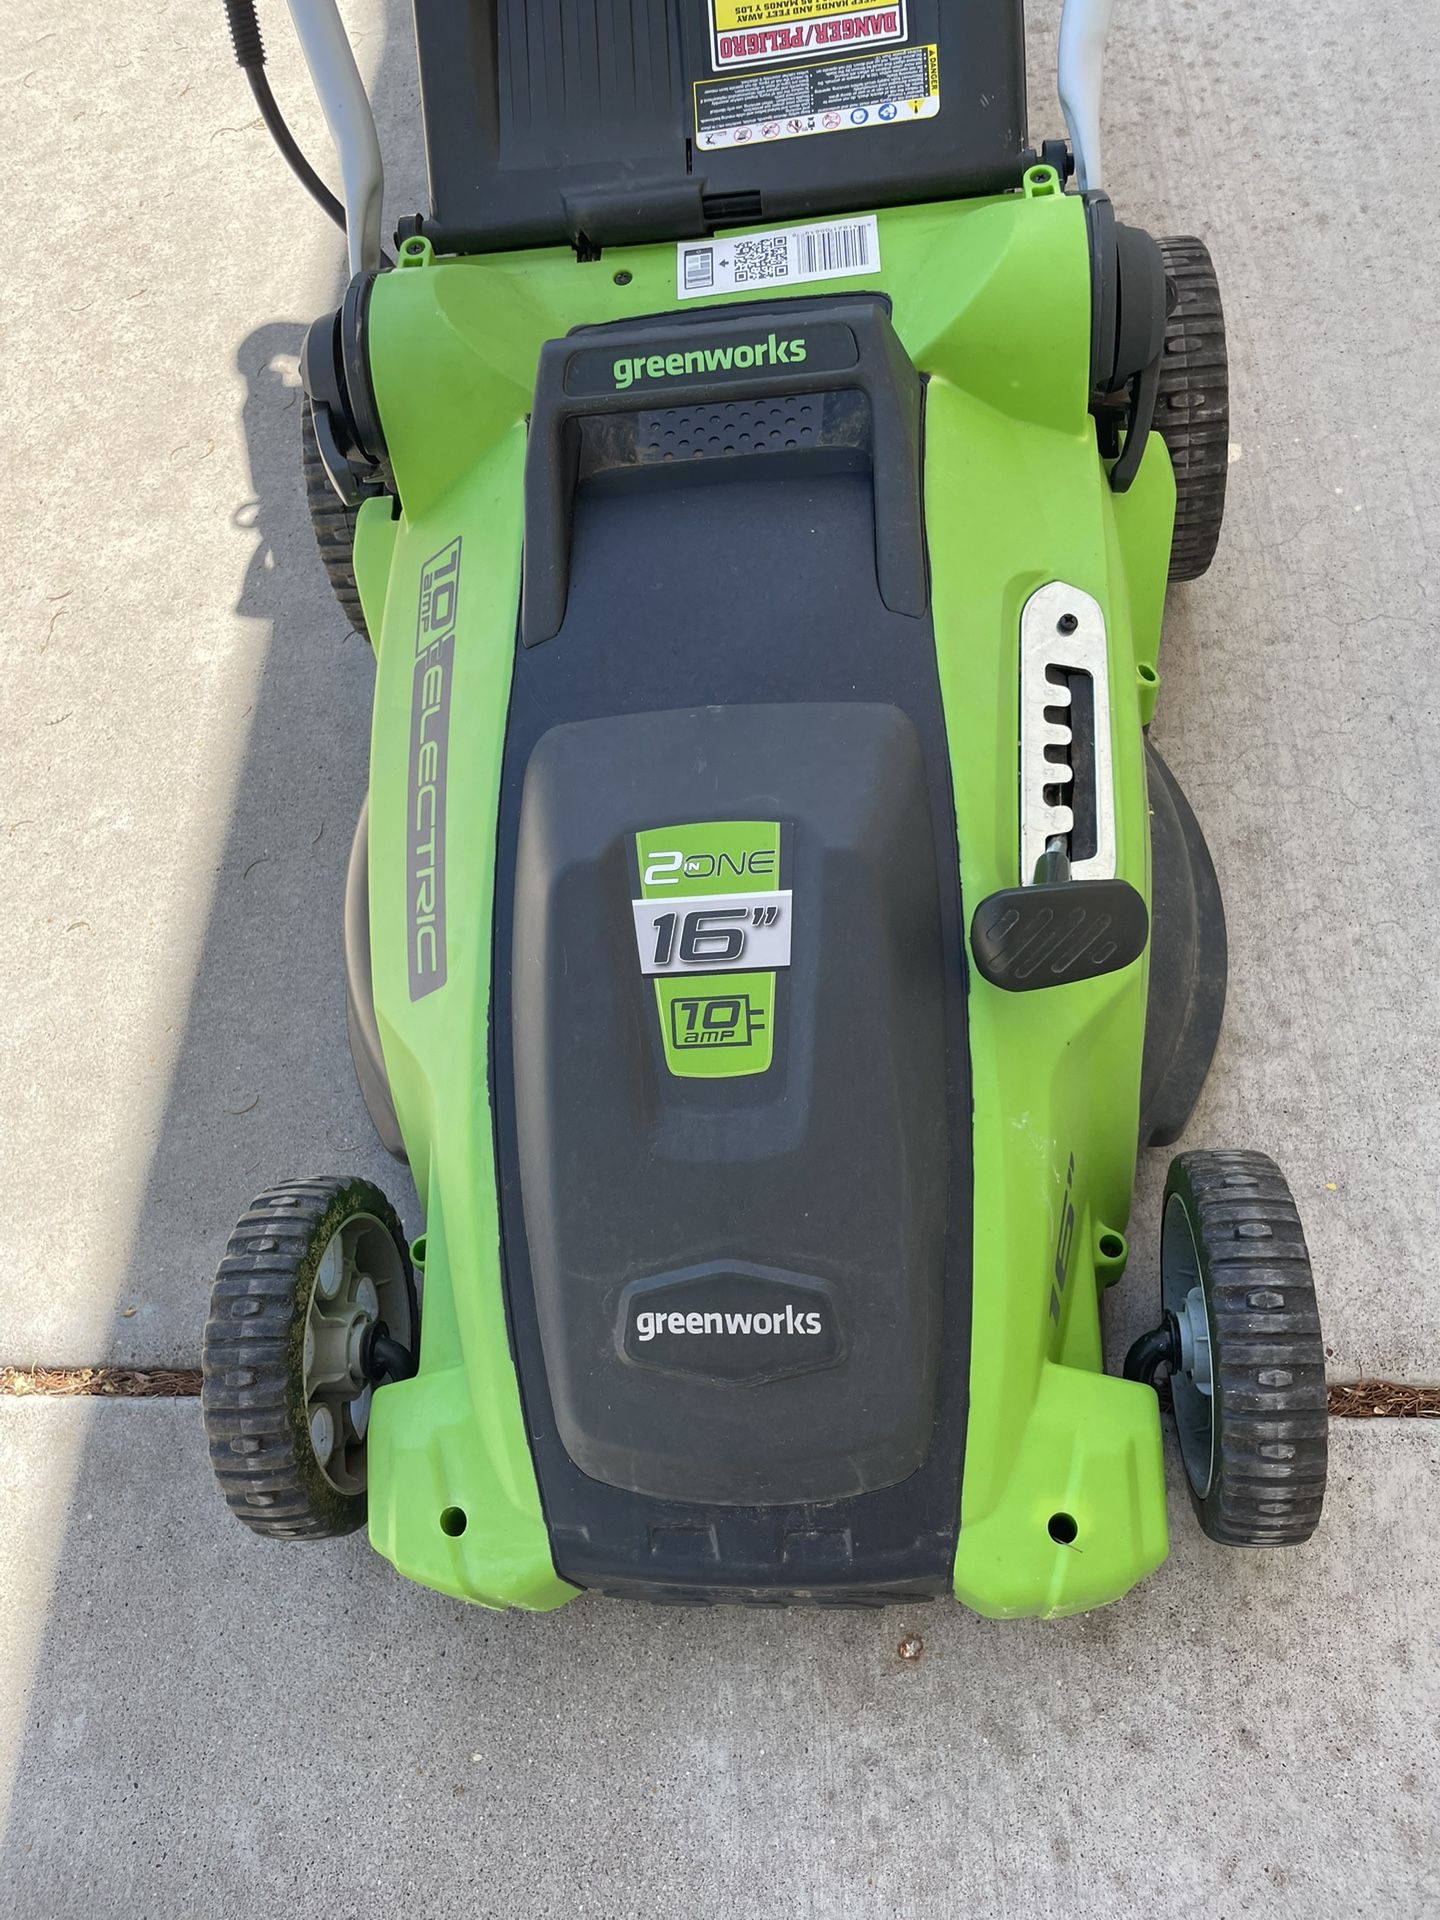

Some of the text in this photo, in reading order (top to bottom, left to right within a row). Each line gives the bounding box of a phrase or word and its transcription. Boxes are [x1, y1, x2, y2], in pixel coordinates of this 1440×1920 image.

[735, 5, 753, 15] LOS
[756, 4, 762, 12] Y
[764, 0, 799, 10] MANOS
[766, 9, 790, 19] FEET
[793, 5, 813, 15] AND
[816, 0, 849, 11] HANDS
[737, 12, 763, 23] AWAY
[719, 11, 898, 59] DANGER/PELIGRO
[930, 57, 938, 90] DANGER
[612, 333, 808, 389] greenworks
[430, 549, 458, 631] 10
[415, 664, 443, 974] ELECTRIC
[680, 1000, 741, 1031] 10
[636, 1304, 822, 1342] greenworks
